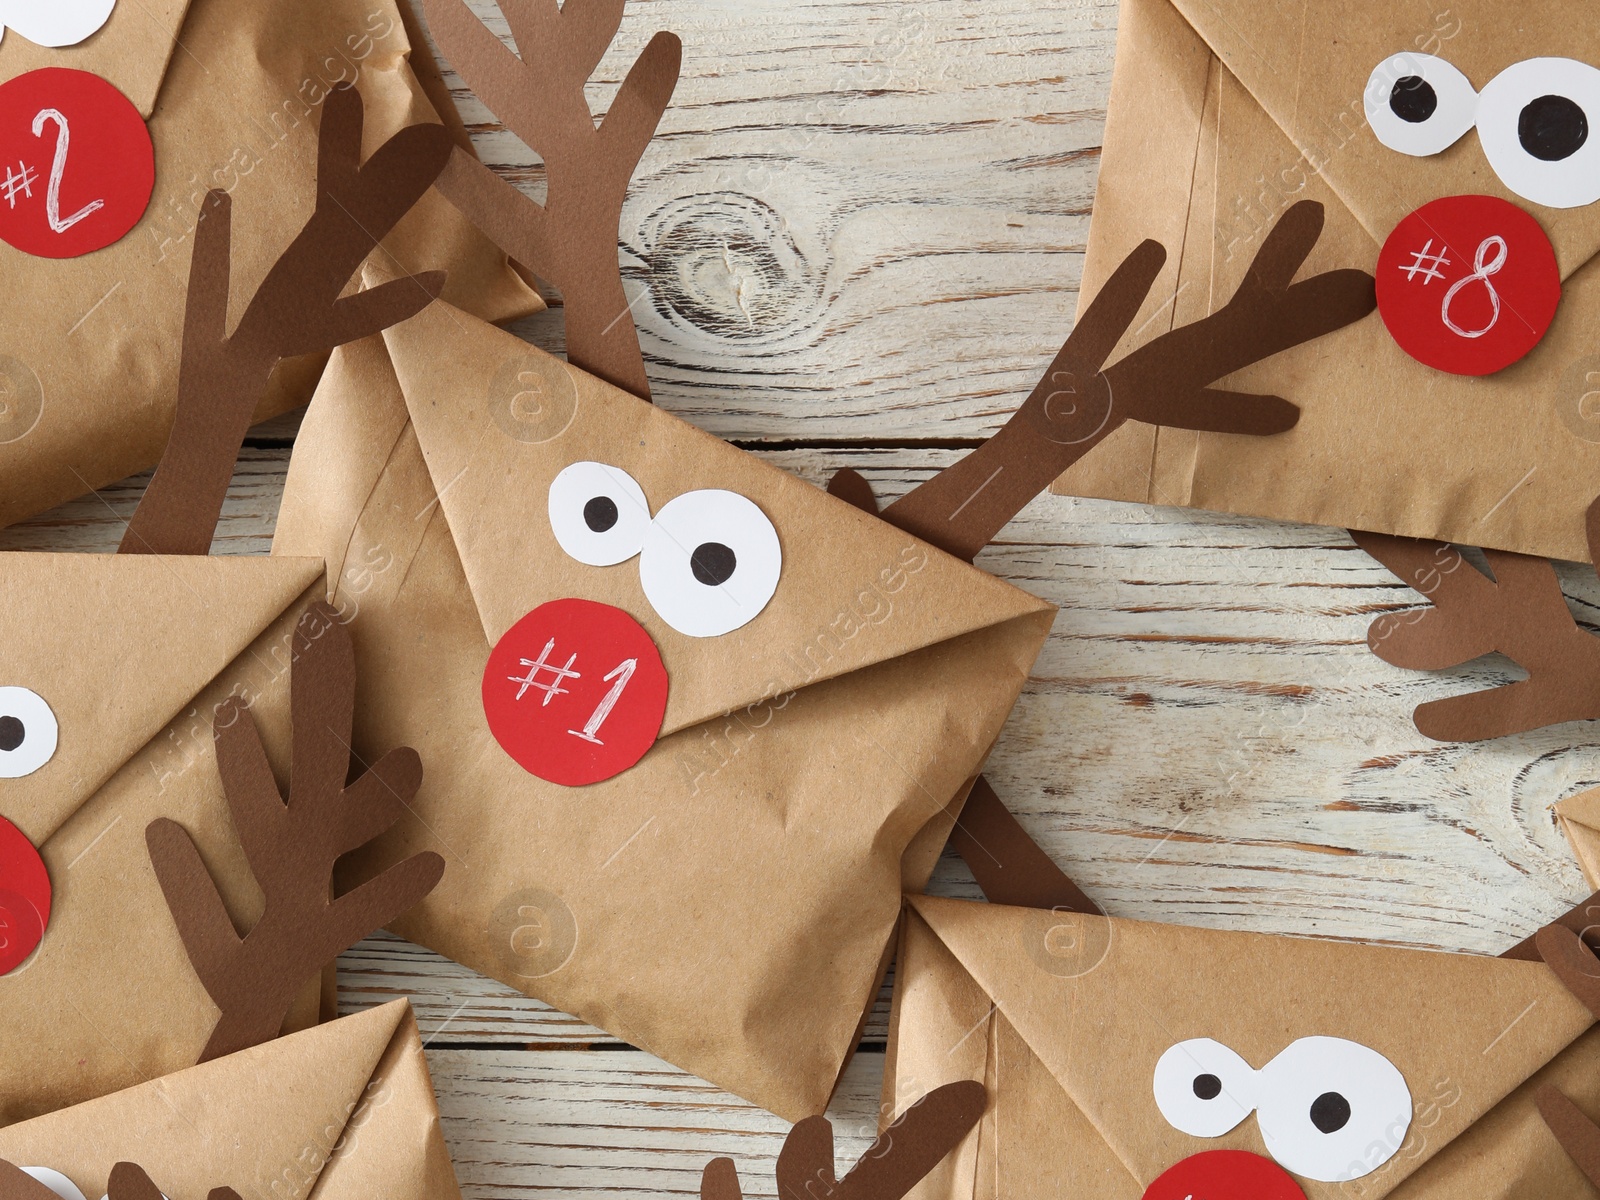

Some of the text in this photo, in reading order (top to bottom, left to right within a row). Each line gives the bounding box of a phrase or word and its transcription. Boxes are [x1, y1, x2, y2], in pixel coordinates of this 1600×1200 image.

[0, 108, 104, 233] #2
[1398, 235, 1508, 338] #8
[507, 637, 638, 746] #1
